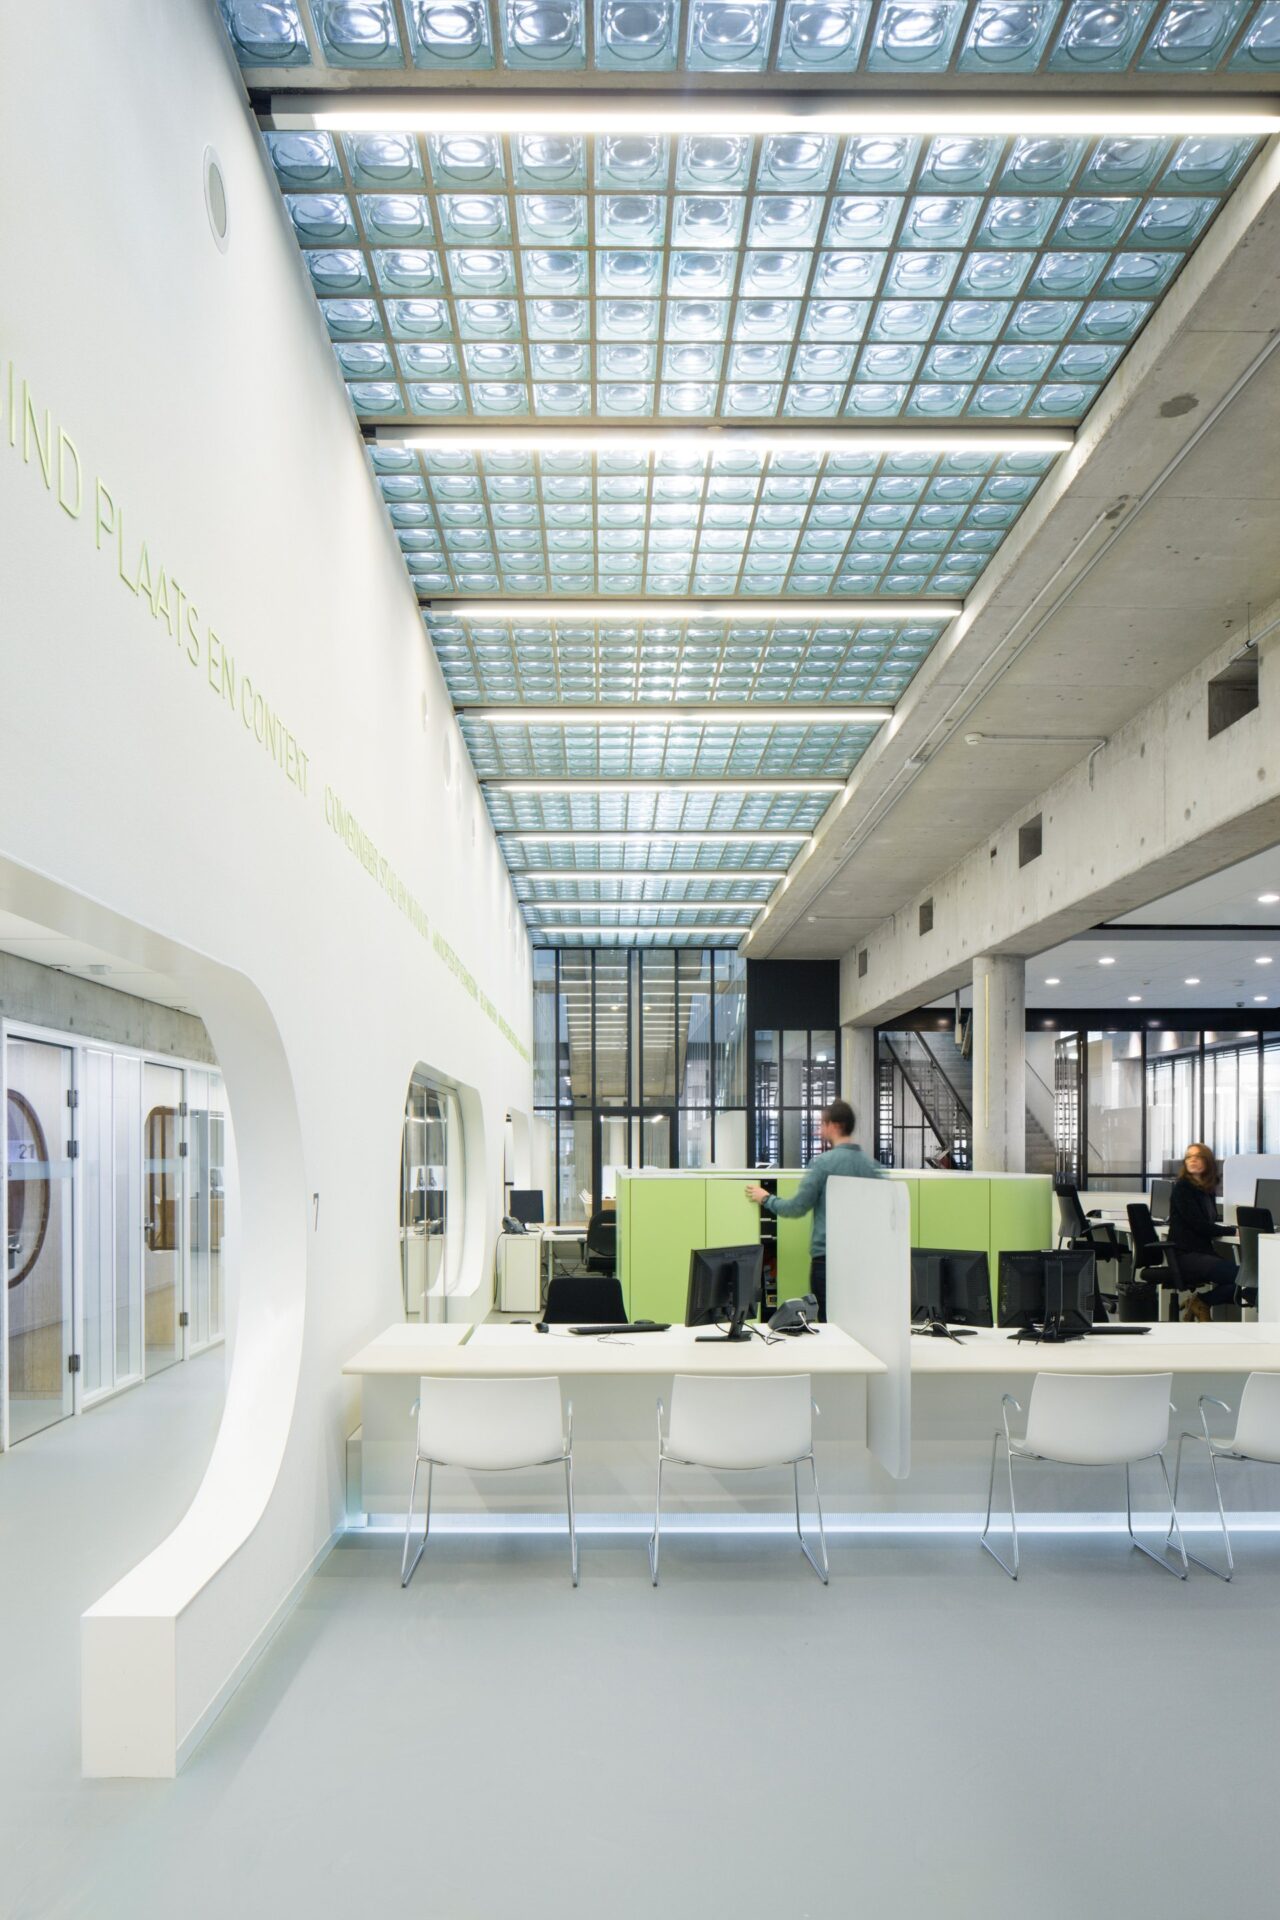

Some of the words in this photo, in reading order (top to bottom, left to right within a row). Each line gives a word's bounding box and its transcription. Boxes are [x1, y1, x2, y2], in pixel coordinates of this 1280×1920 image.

[0, 360, 82, 519] IND
[96, 476, 200, 667] PLAATS
[207, 626, 235, 711] EN
[241, 675, 310, 797] CONTEXT
[18, 1143, 35, 1159] 21
